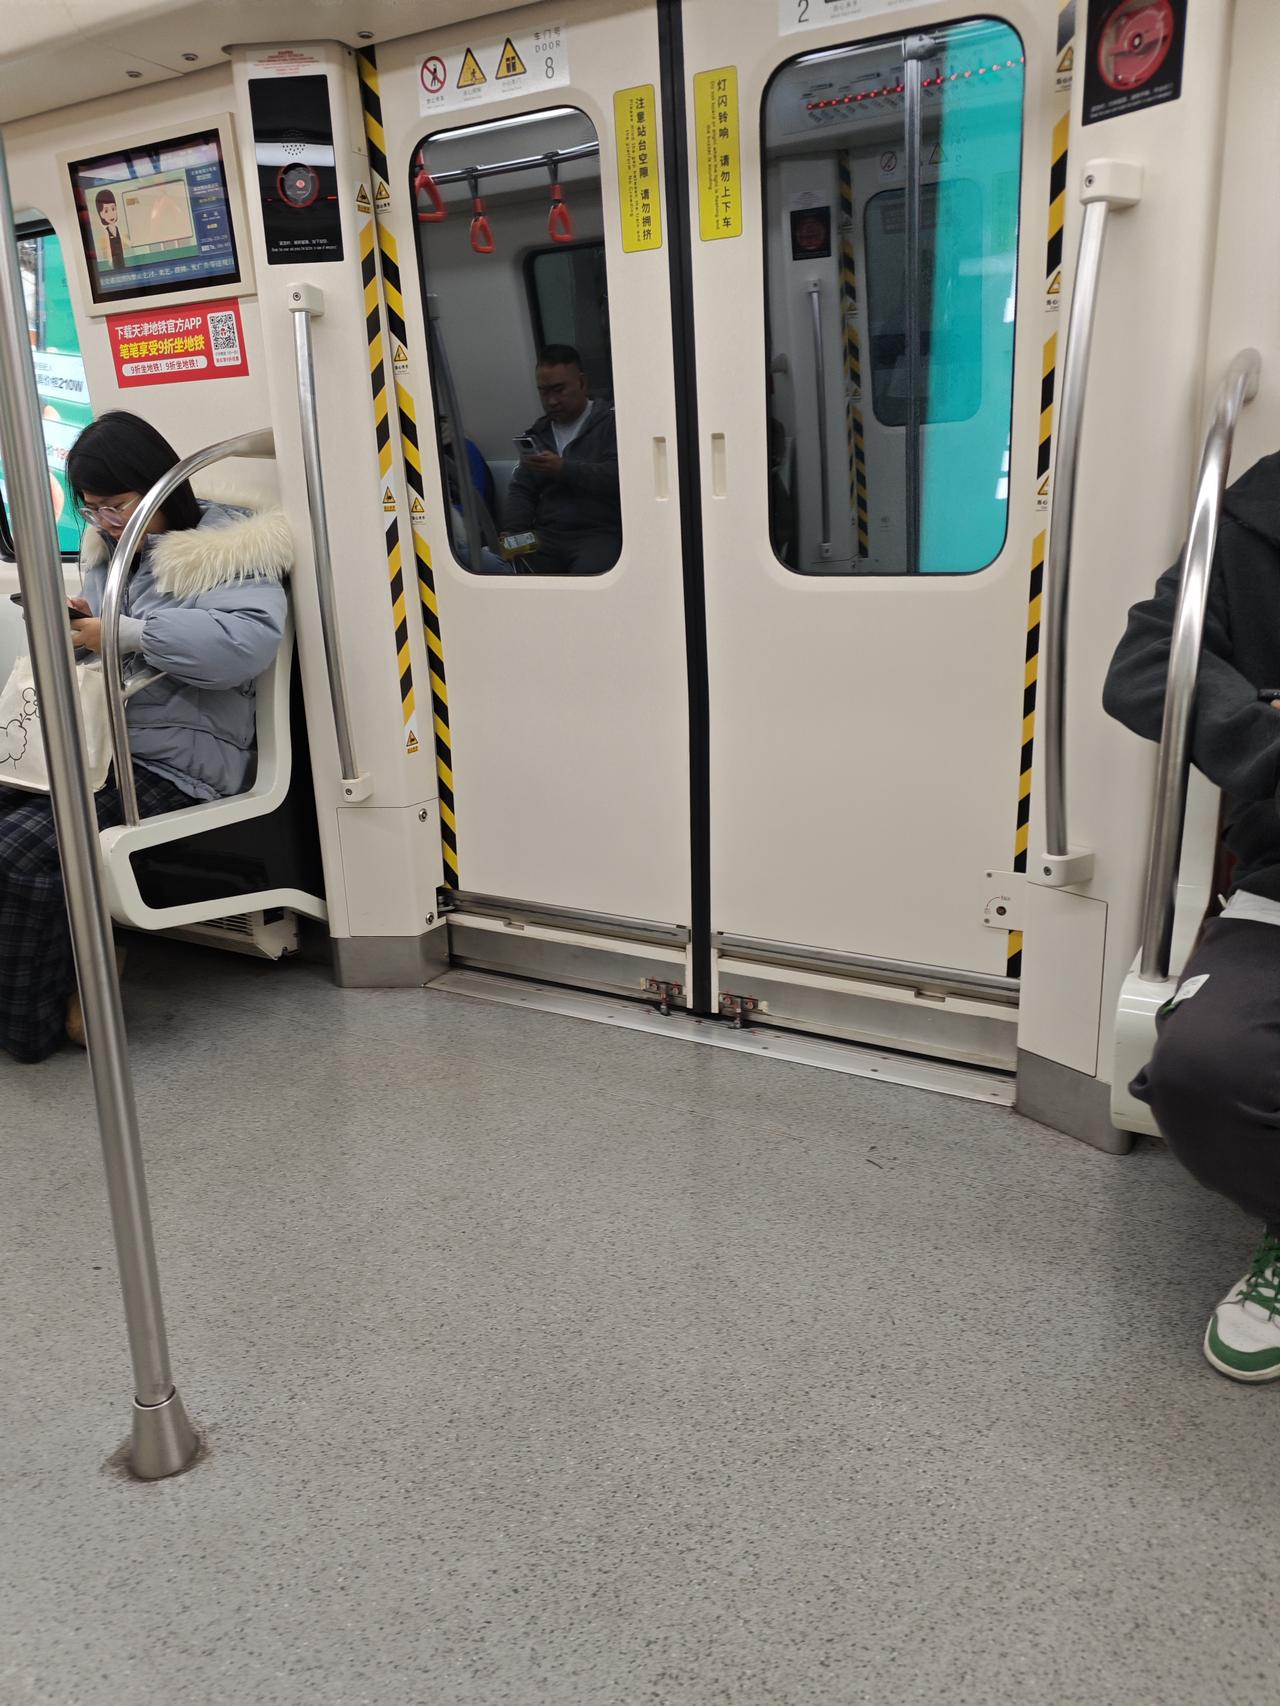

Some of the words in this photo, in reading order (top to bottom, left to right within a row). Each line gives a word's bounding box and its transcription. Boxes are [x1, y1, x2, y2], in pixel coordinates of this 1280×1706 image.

[798, 0, 809, 23] 2
[534, 26, 561, 40] 车门号
[535, 39, 561, 53] DOOR
[545, 56, 555, 79] 8
[717, 78, 729, 139] 灯闪铃响
[720, 154, 732, 228] 请勿上下车
[641, 188, 653, 240] 请勿拥挤
[115, 317, 202, 340] 下载天津地铁官方APP
[119, 335, 205, 359] 笔笔享受9折坐地铁
